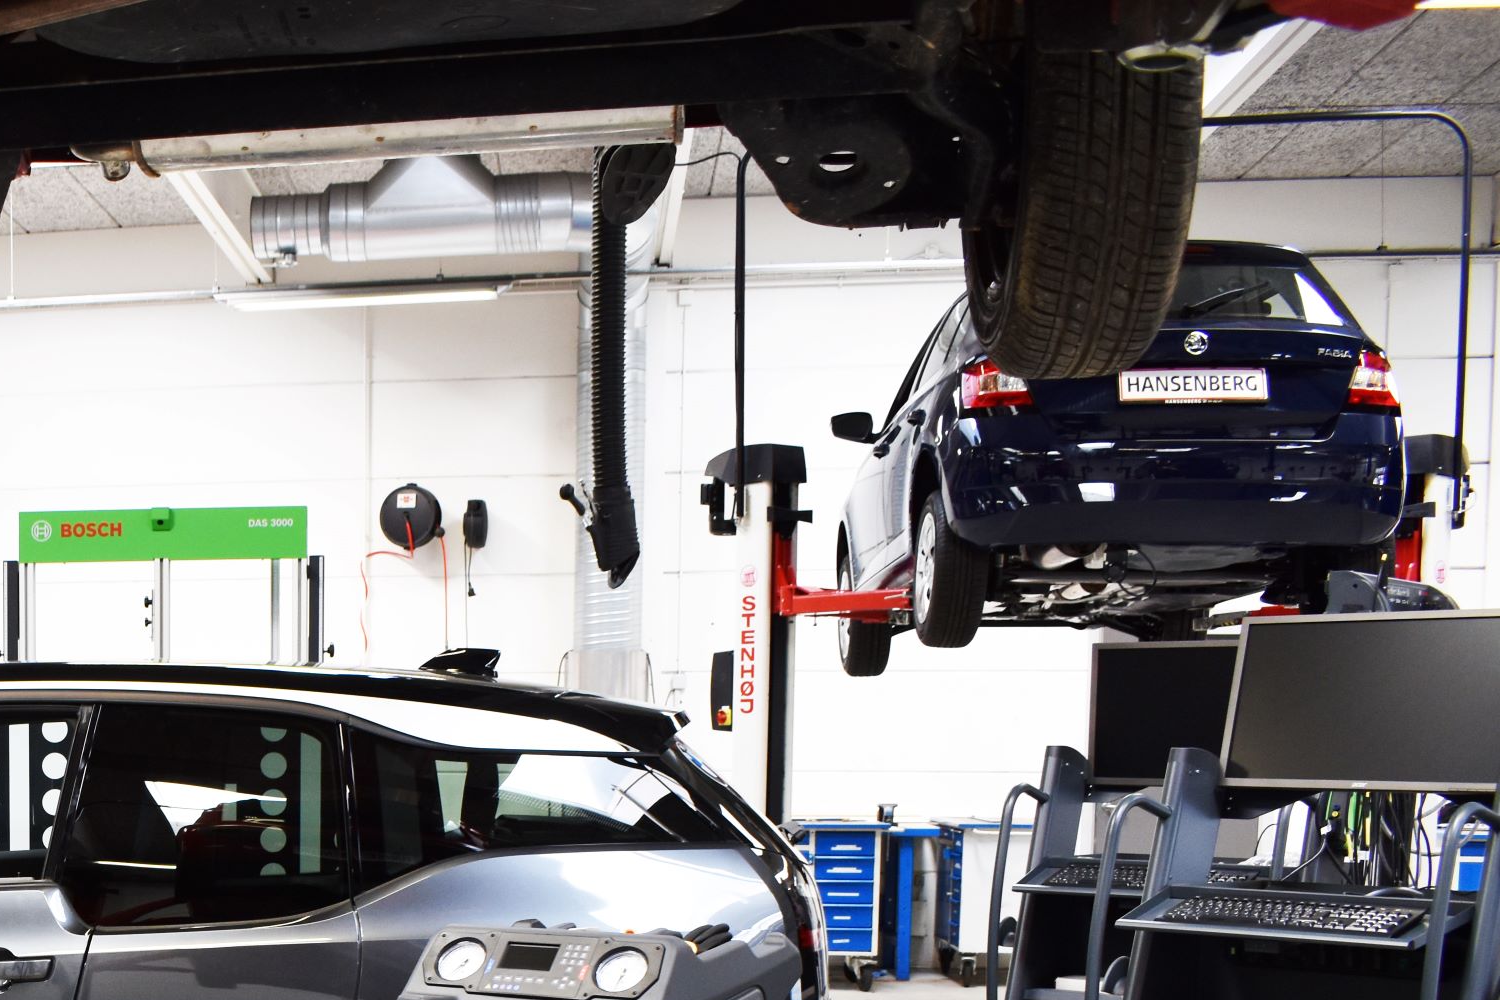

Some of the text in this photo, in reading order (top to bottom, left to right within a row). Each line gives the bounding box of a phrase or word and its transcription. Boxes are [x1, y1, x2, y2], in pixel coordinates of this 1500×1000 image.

[1127, 375, 1258, 393] HANSENBERG
[60, 522, 122, 538] BOSCH
[248, 518, 294, 528] DAS 3000
[740, 595, 756, 714] STENHØJ
